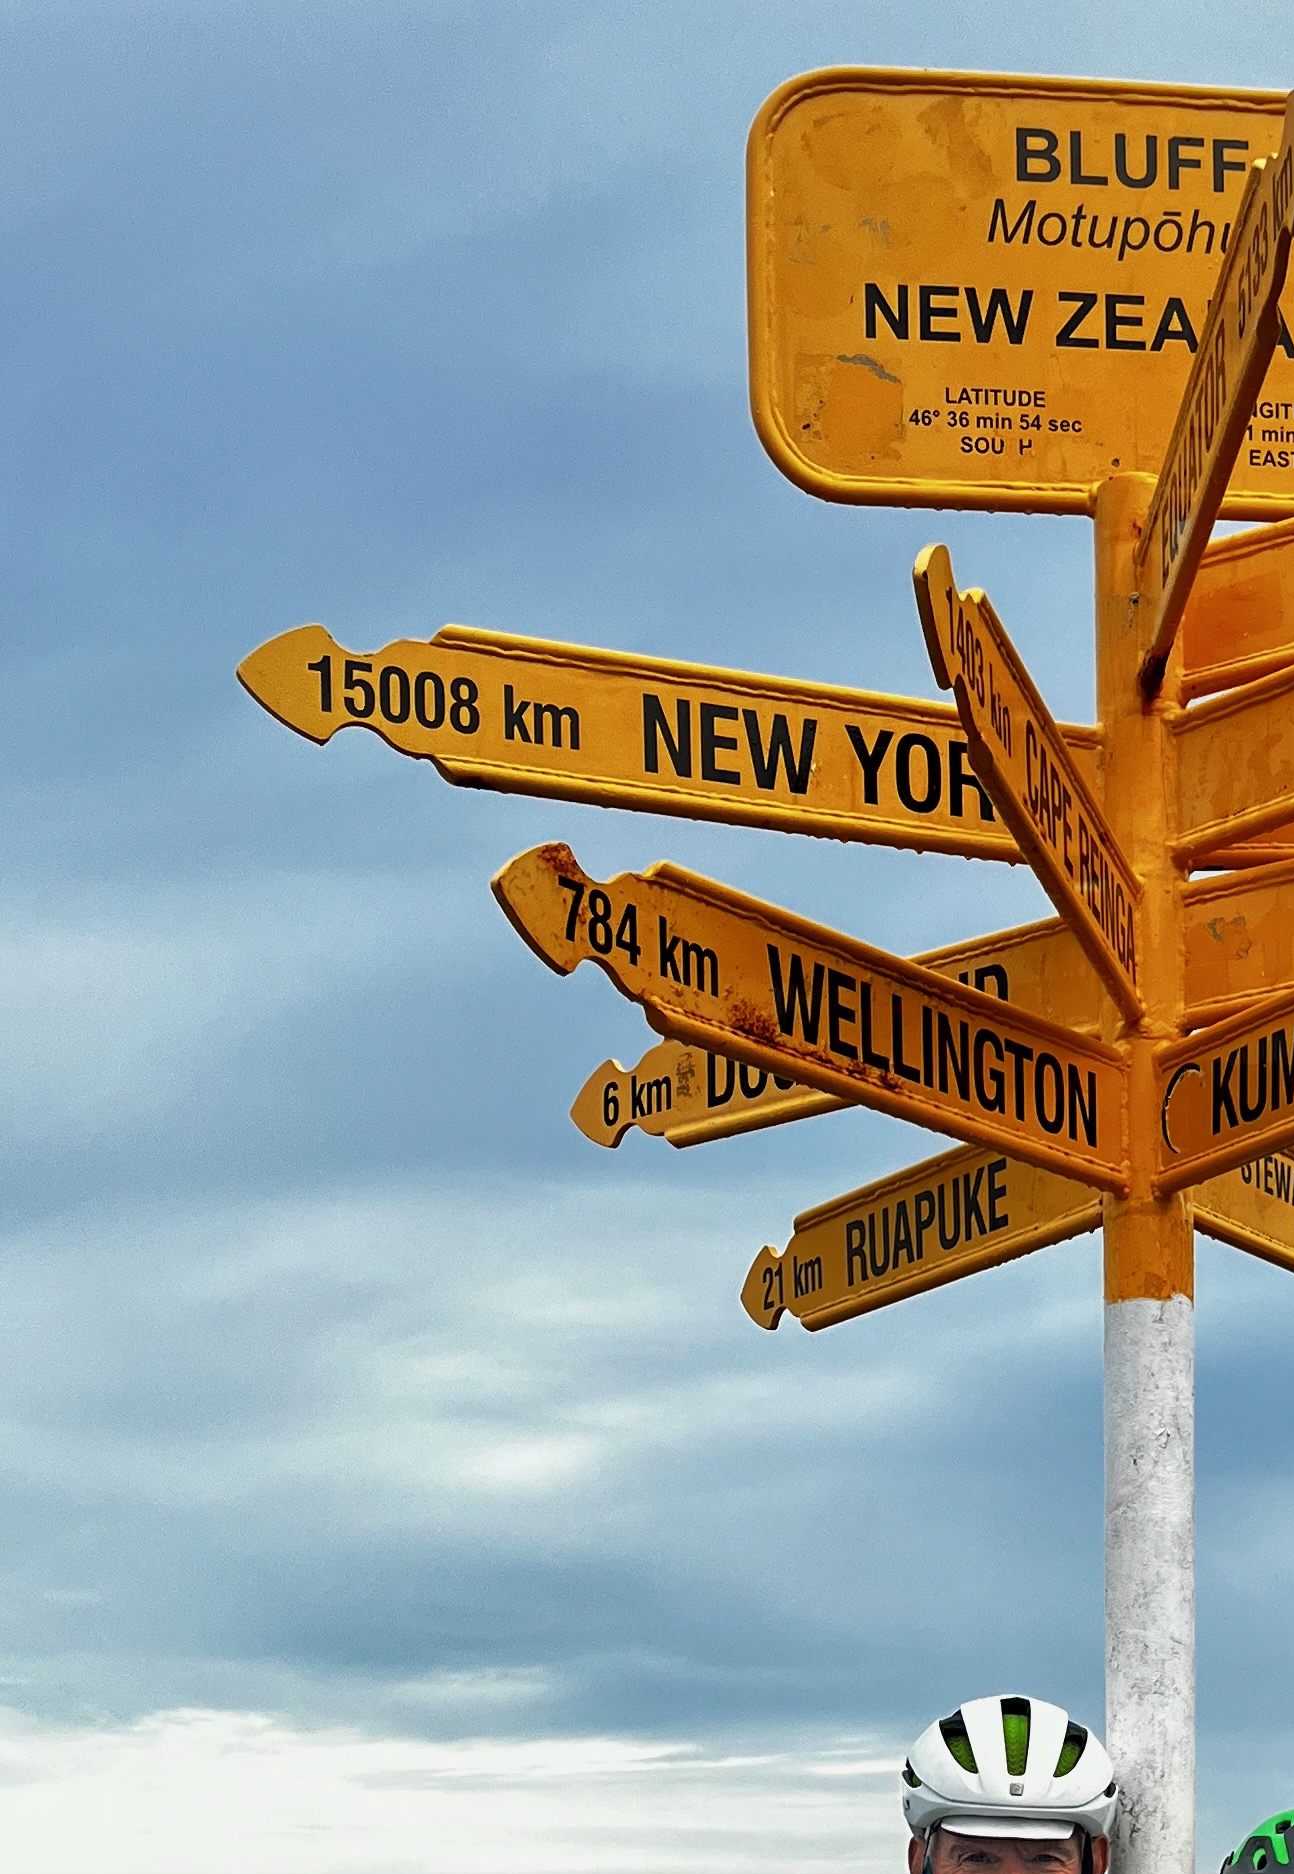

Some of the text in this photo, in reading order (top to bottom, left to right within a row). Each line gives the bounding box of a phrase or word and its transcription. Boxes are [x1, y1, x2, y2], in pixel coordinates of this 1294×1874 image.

[1015, 127, 1249, 192] BLUFF
[988, 198, 1230, 261] Motupōh
[865, 283, 1034, 345] NEW
[945, 387, 1046, 408] LATITUDE
[1161, 145, 1293, 590] EQUATOR 5133 km
[909, 409, 1082, 432] 46° 36 min 54 sec
[960, 436, 1032, 455] SOUH
[307, 654, 996, 822] 15008 km NEW YOR
[945, 585, 1137, 985] 1403 km CAPE REINGA
[557, 875, 641, 967] 784
[658, 915, 719, 998] km
[767, 943, 1098, 1148] WELLINGTON
[603, 1081, 619, 1127] 6
[631, 1075, 672, 1119] km
[762, 1157, 1008, 1310] 21 km RUAPUKE
